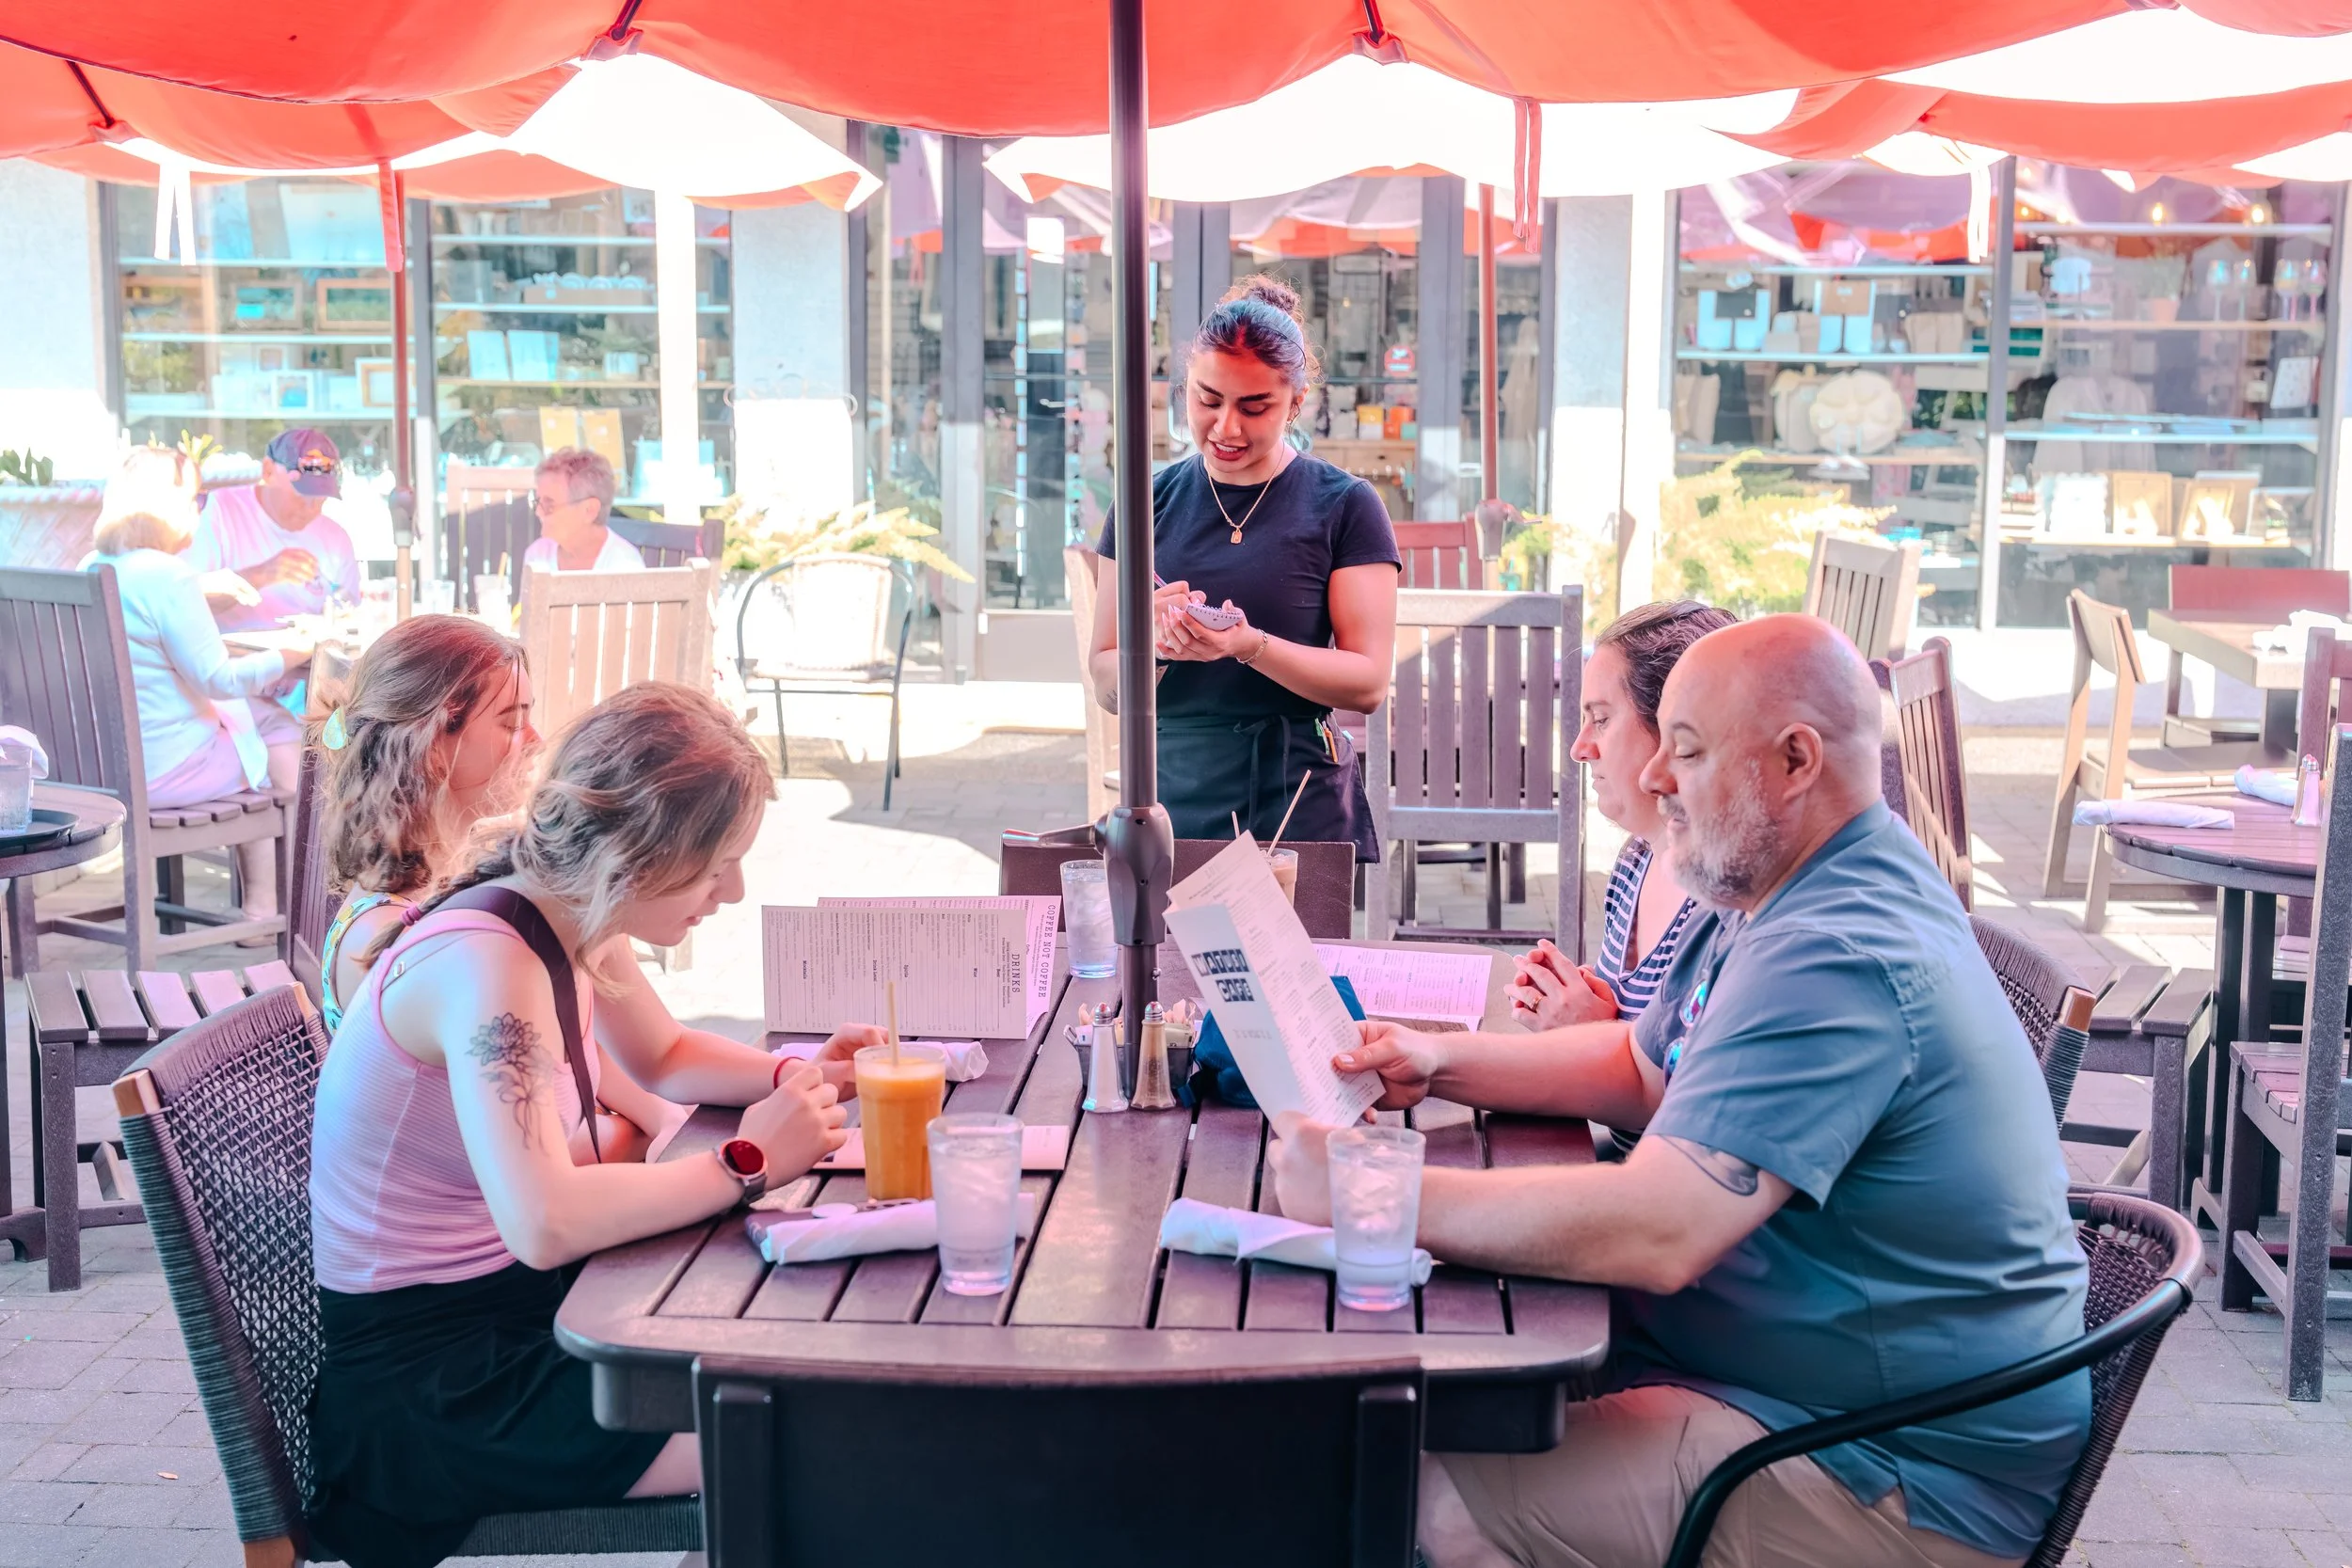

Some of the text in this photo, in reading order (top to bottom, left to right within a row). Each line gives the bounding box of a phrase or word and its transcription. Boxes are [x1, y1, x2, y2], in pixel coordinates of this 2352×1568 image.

[1044, 905, 1056, 938] COFFEE
[1041, 942, 1051, 958] NOT
[1191, 948, 1249, 976] WATUSI
[1011, 954, 1021, 993] DRINKS
[1038, 962, 1049, 998] COFFEE
[1216, 978, 1254, 1002] CAFE
